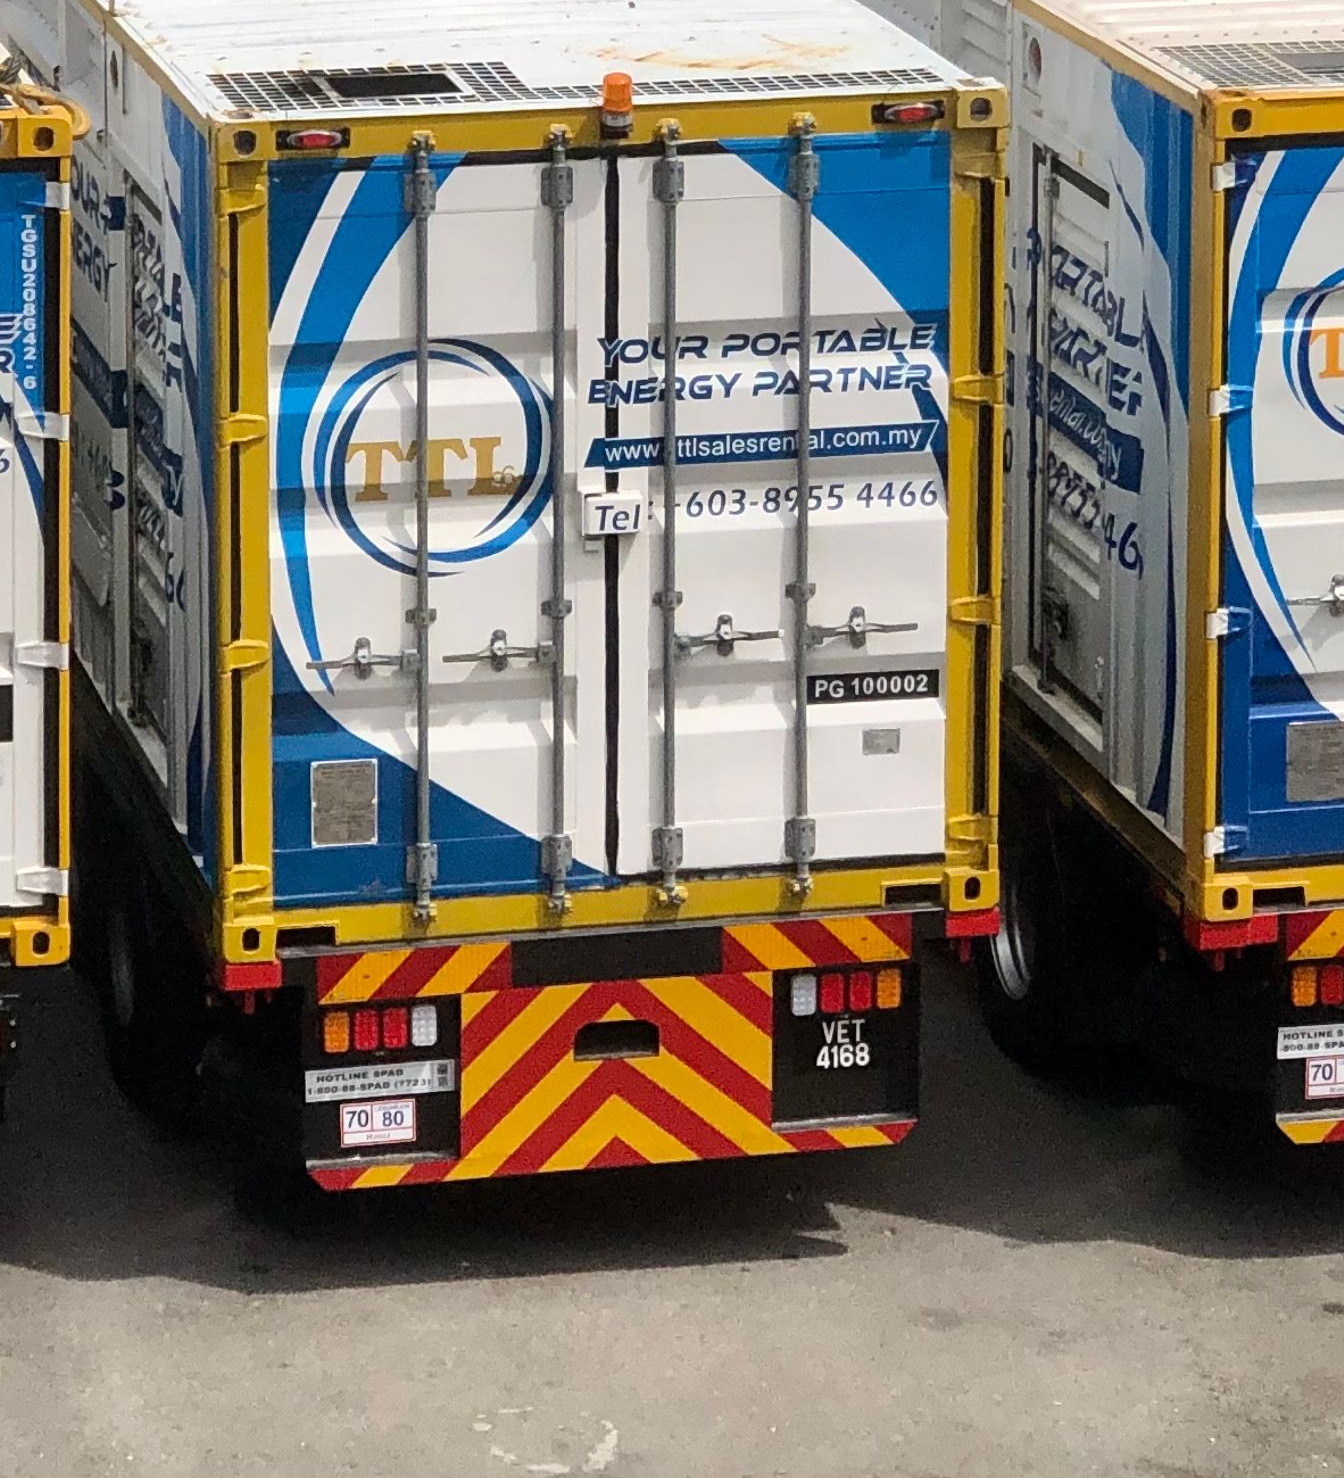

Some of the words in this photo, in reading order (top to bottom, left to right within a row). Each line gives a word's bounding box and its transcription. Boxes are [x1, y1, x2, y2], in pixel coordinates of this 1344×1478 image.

[20, 214, 38, 390] TGSU208642-6
[597, 334, 709, 366] YOUR
[721, 324, 935, 358] PORTABLE
[587, 373, 742, 408] ENERGY
[752, 364, 932, 397] PARTNER
[605, 428, 922, 463] wwwttlsalesrenal.com.my
[346, 436, 524, 502] TTL
[595, 503, 641, 532] Tel
[856, 479, 939, 509] 4466
[814, 679, 845, 699] PG
[850, 673, 929, 696] 100002
[821, 1018, 866, 1044] VET
[1283, 1029, 1333, 1041] HOTLINE
[816, 1042, 870, 1069] 4168
[316, 1070, 369, 1083] HOTLINE
[1310, 1063, 1334, 1082] 70
[345, 1109, 369, 1129] 70
[382, 1110, 405, 1128] 80
